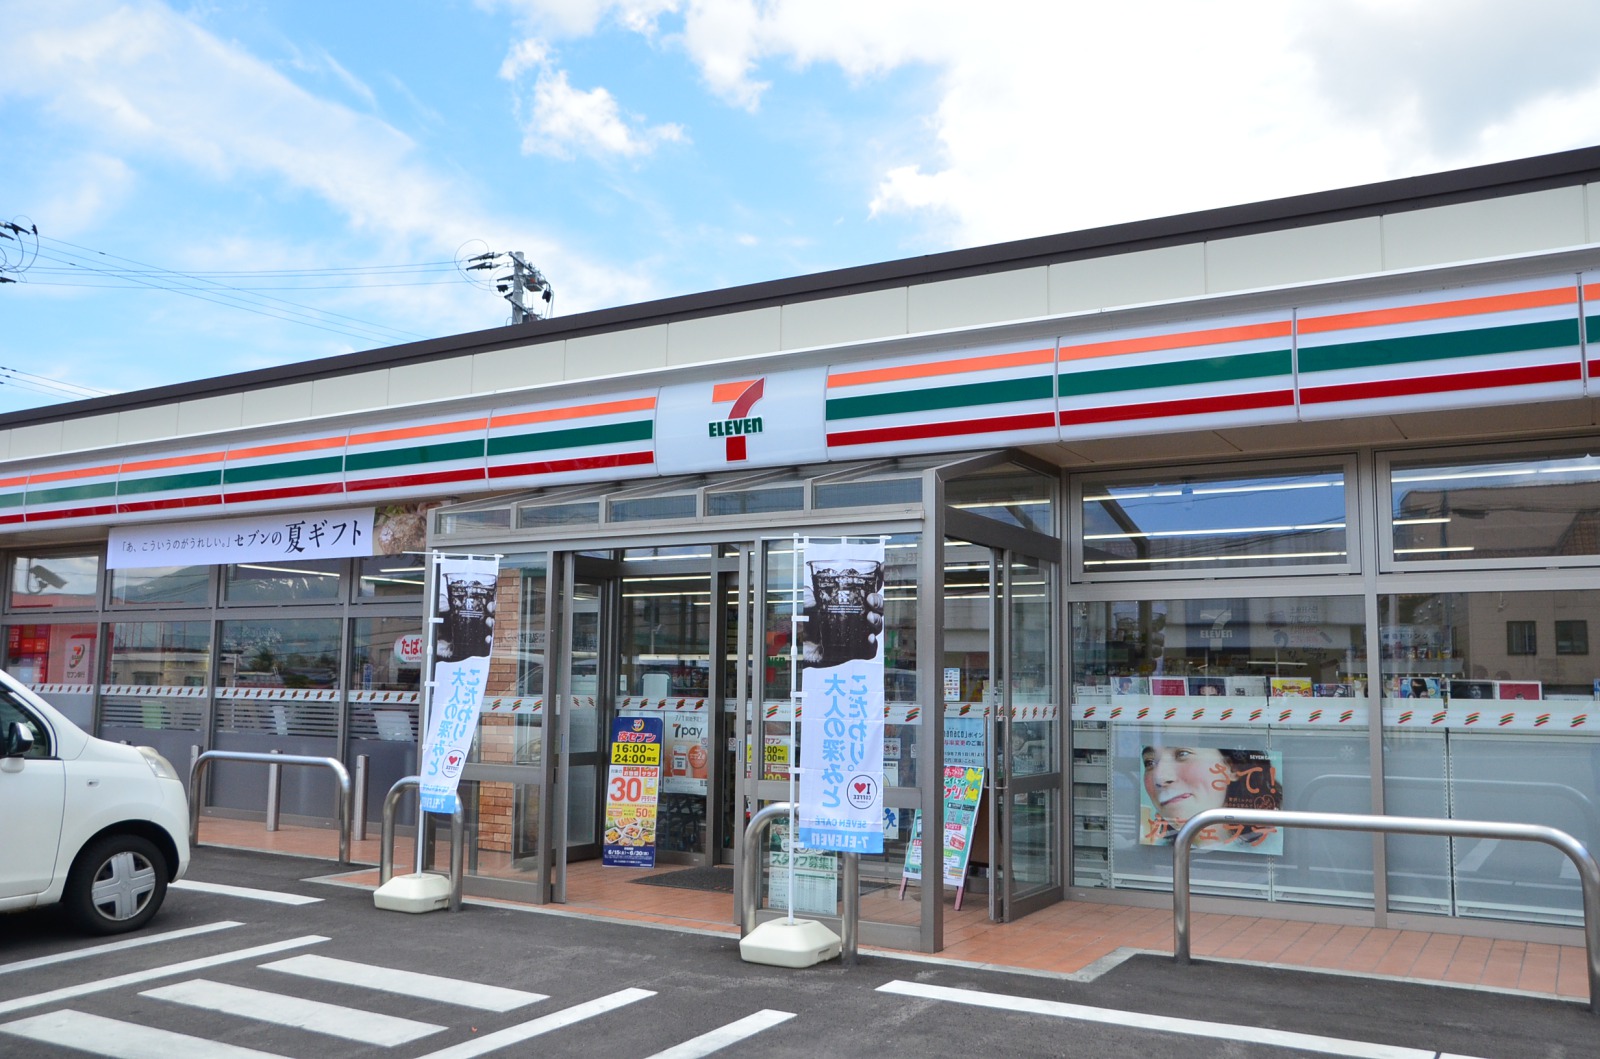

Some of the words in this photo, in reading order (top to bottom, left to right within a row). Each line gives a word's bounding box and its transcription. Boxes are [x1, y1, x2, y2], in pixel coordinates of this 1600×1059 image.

[618, 731, 657, 743] 夜セブン
[672, 723, 703, 739] 7pay
[610, 777, 642, 802] 30
[635, 808, 648, 818] 50
